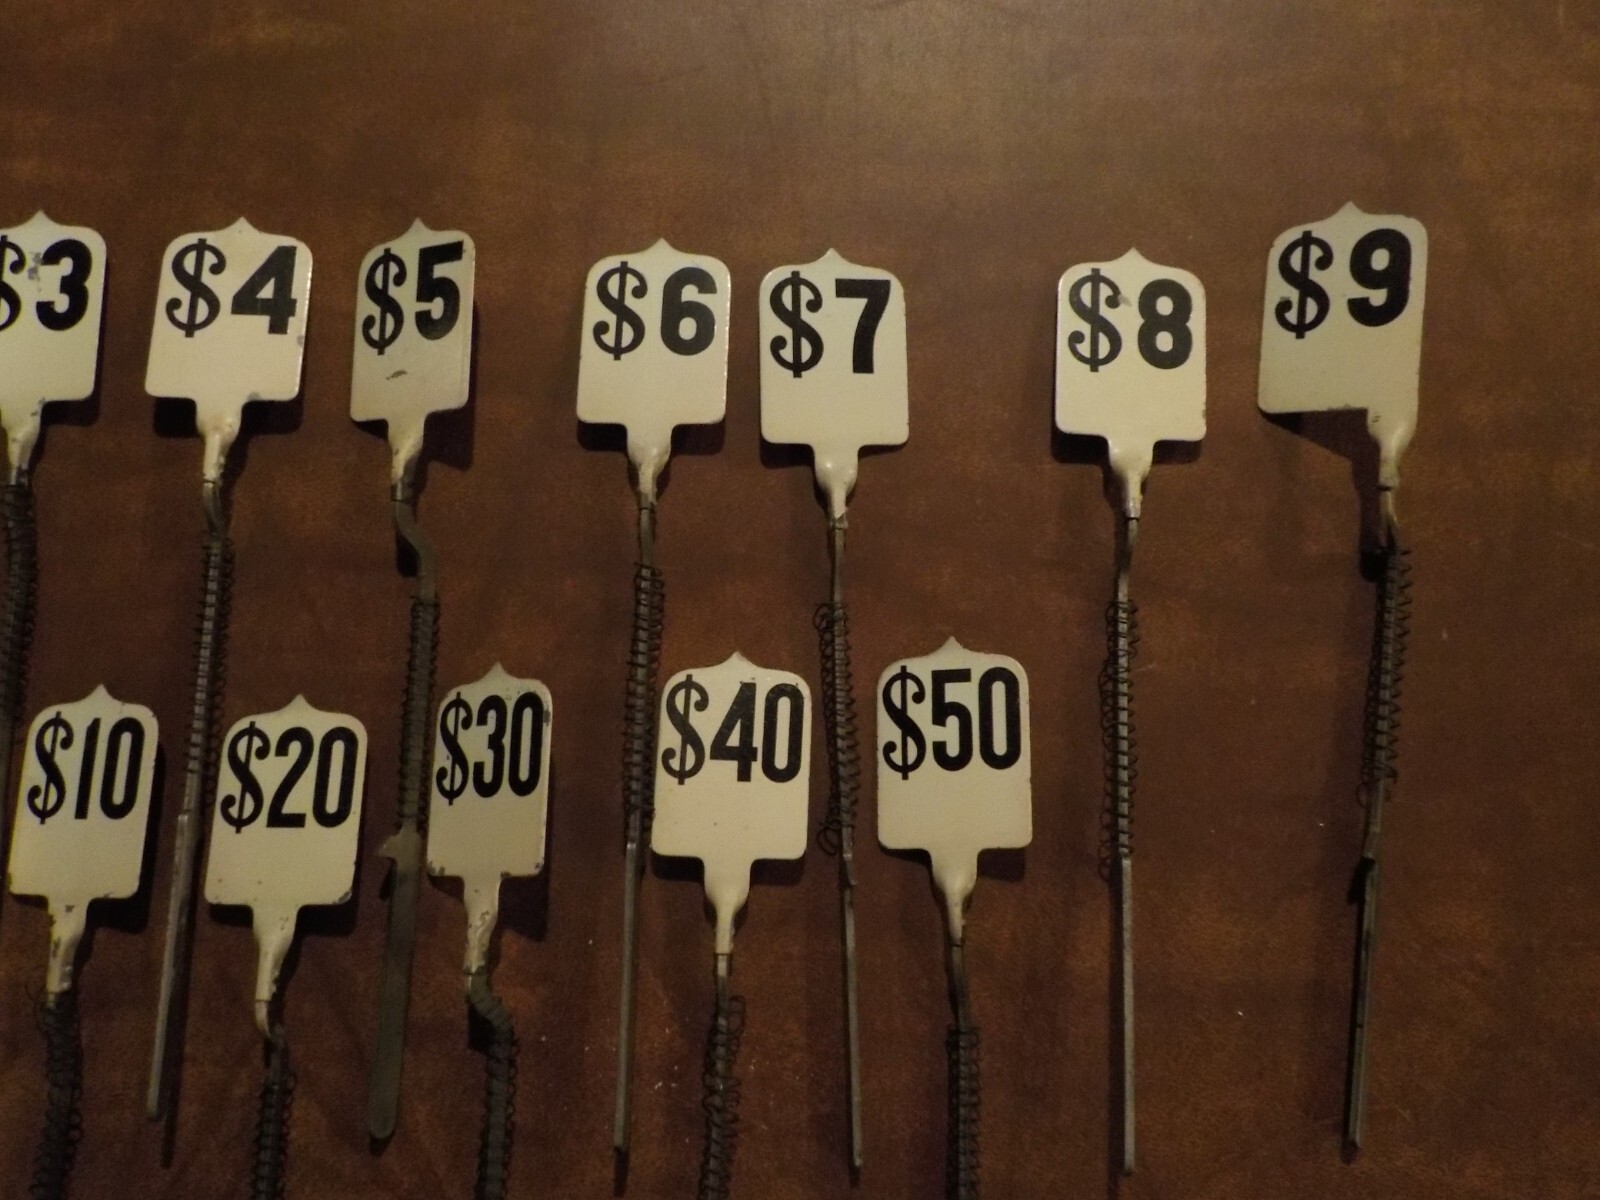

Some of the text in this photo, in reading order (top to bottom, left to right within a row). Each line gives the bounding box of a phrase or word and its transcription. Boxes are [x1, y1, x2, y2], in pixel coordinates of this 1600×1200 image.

[165, 238, 297, 338] $4
[362, 240, 464, 356] $5
[592, 261, 717, 361] $6
[769, 271, 891, 378] $7
[1068, 267, 1193, 372] $8
[1274, 228, 1413, 340] $9
[27, 711, 145, 825] $10
[220, 720, 358, 834] $20
[435, 691, 544, 806] $30
[661, 674, 805, 786] $40
[882, 665, 1022, 781] $50
